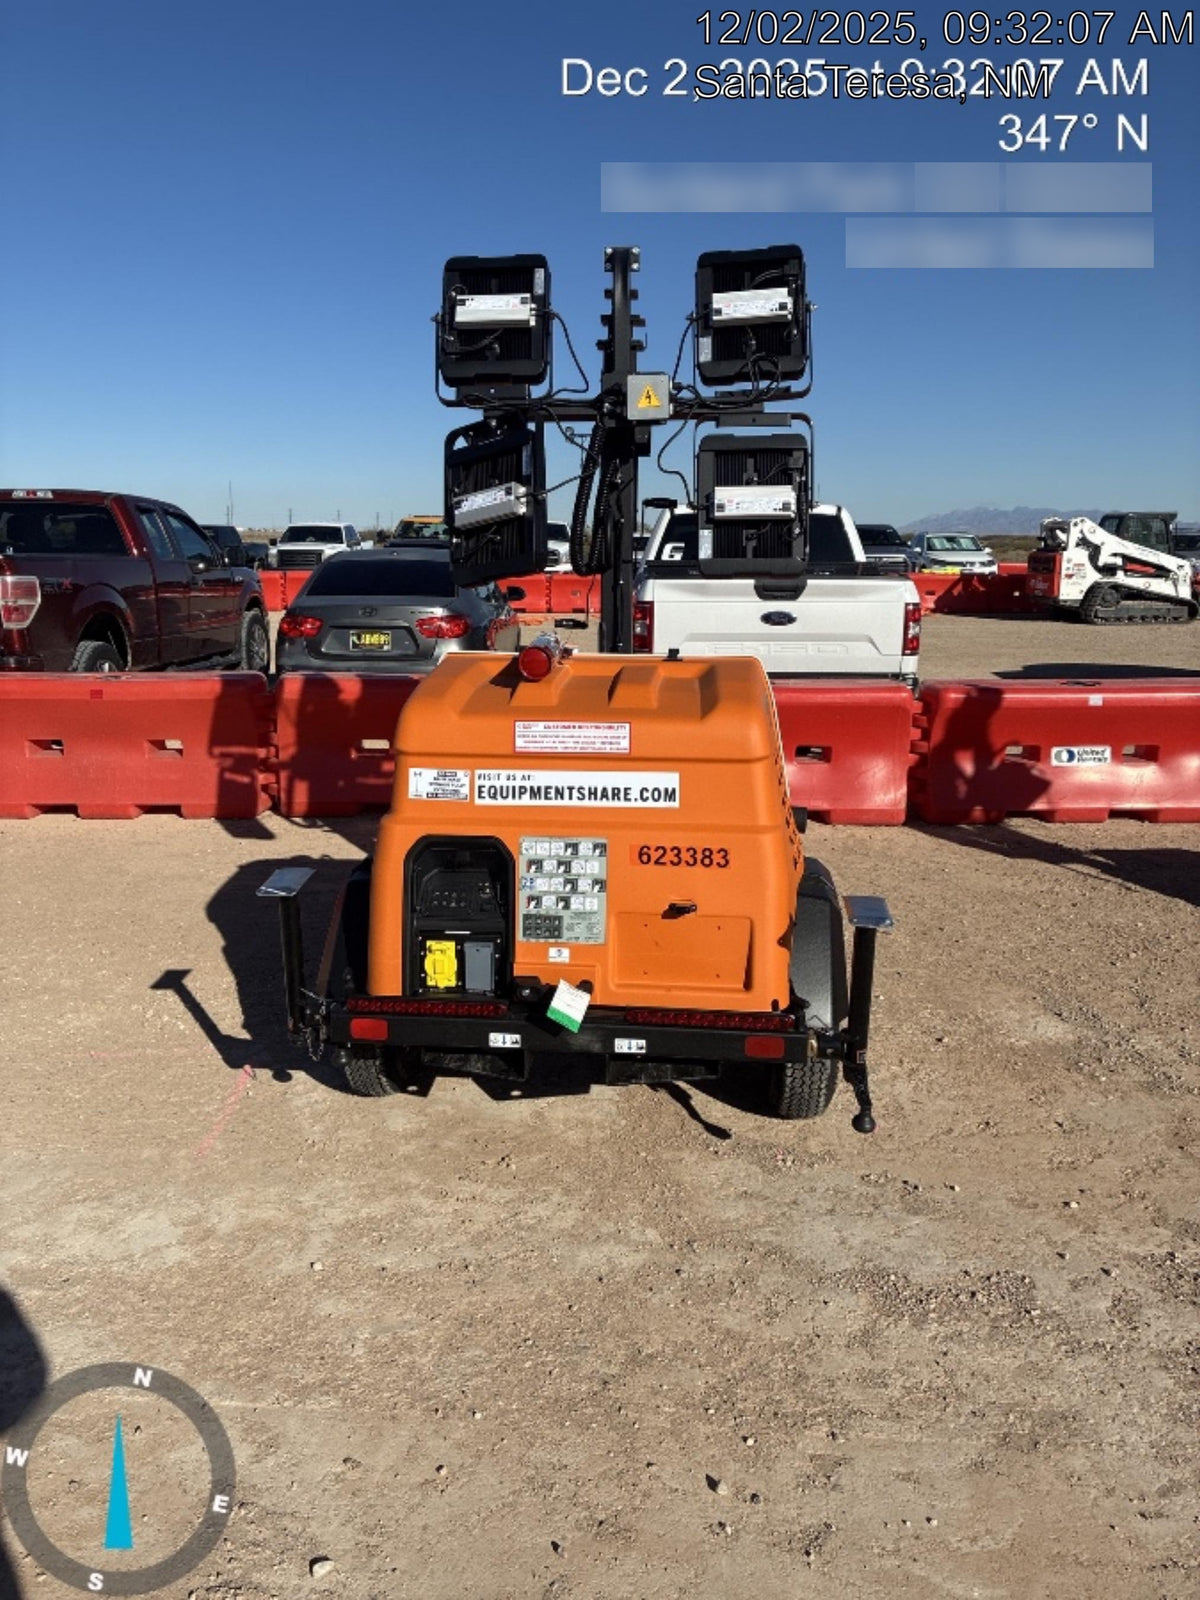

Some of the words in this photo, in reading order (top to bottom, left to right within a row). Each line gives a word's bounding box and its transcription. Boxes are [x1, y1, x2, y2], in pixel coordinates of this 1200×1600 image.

[477, 772, 501, 782] VISIT
[506, 773, 517, 782] US
[477, 784, 677, 804] EQUIPMENTSHARE.COM
[638, 845, 730, 869] 623383
